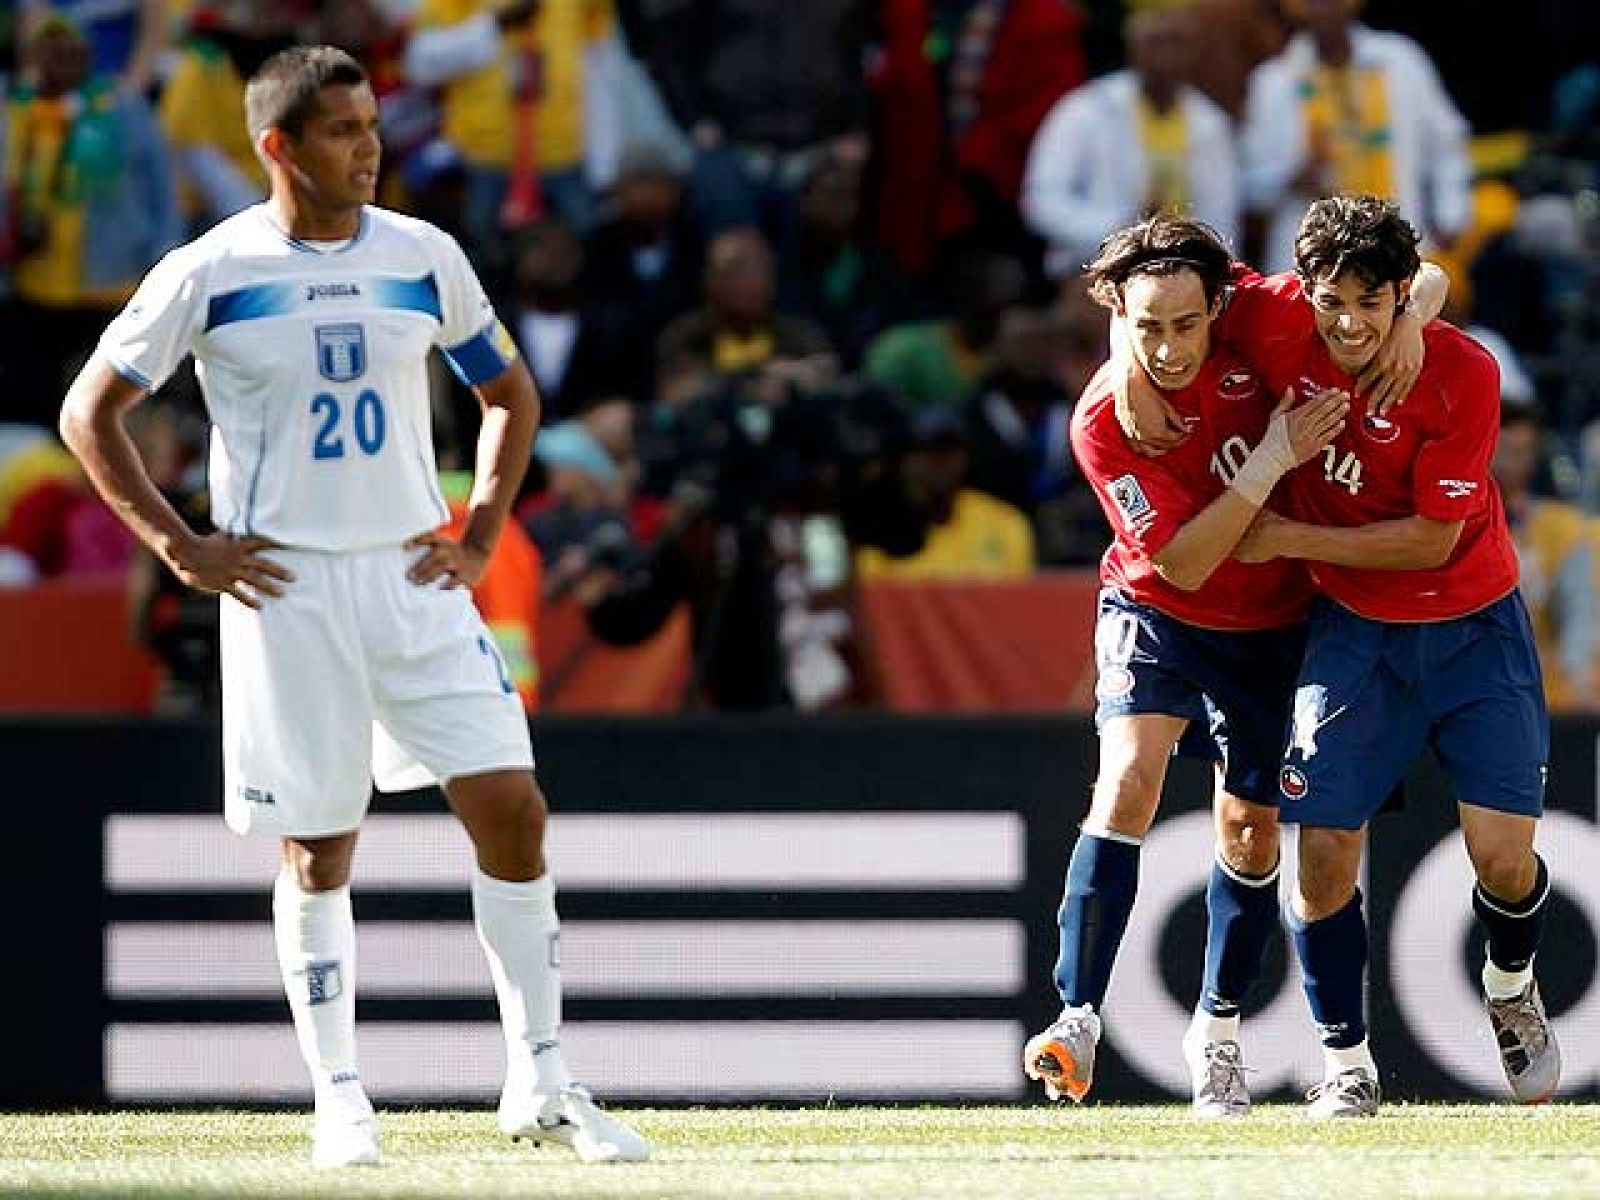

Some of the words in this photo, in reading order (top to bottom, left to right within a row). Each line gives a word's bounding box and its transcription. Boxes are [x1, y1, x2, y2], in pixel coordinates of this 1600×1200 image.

[310, 389, 386, 461] 20
[1209, 435, 1252, 486] 10
[1321, 444, 1364, 496] 14
